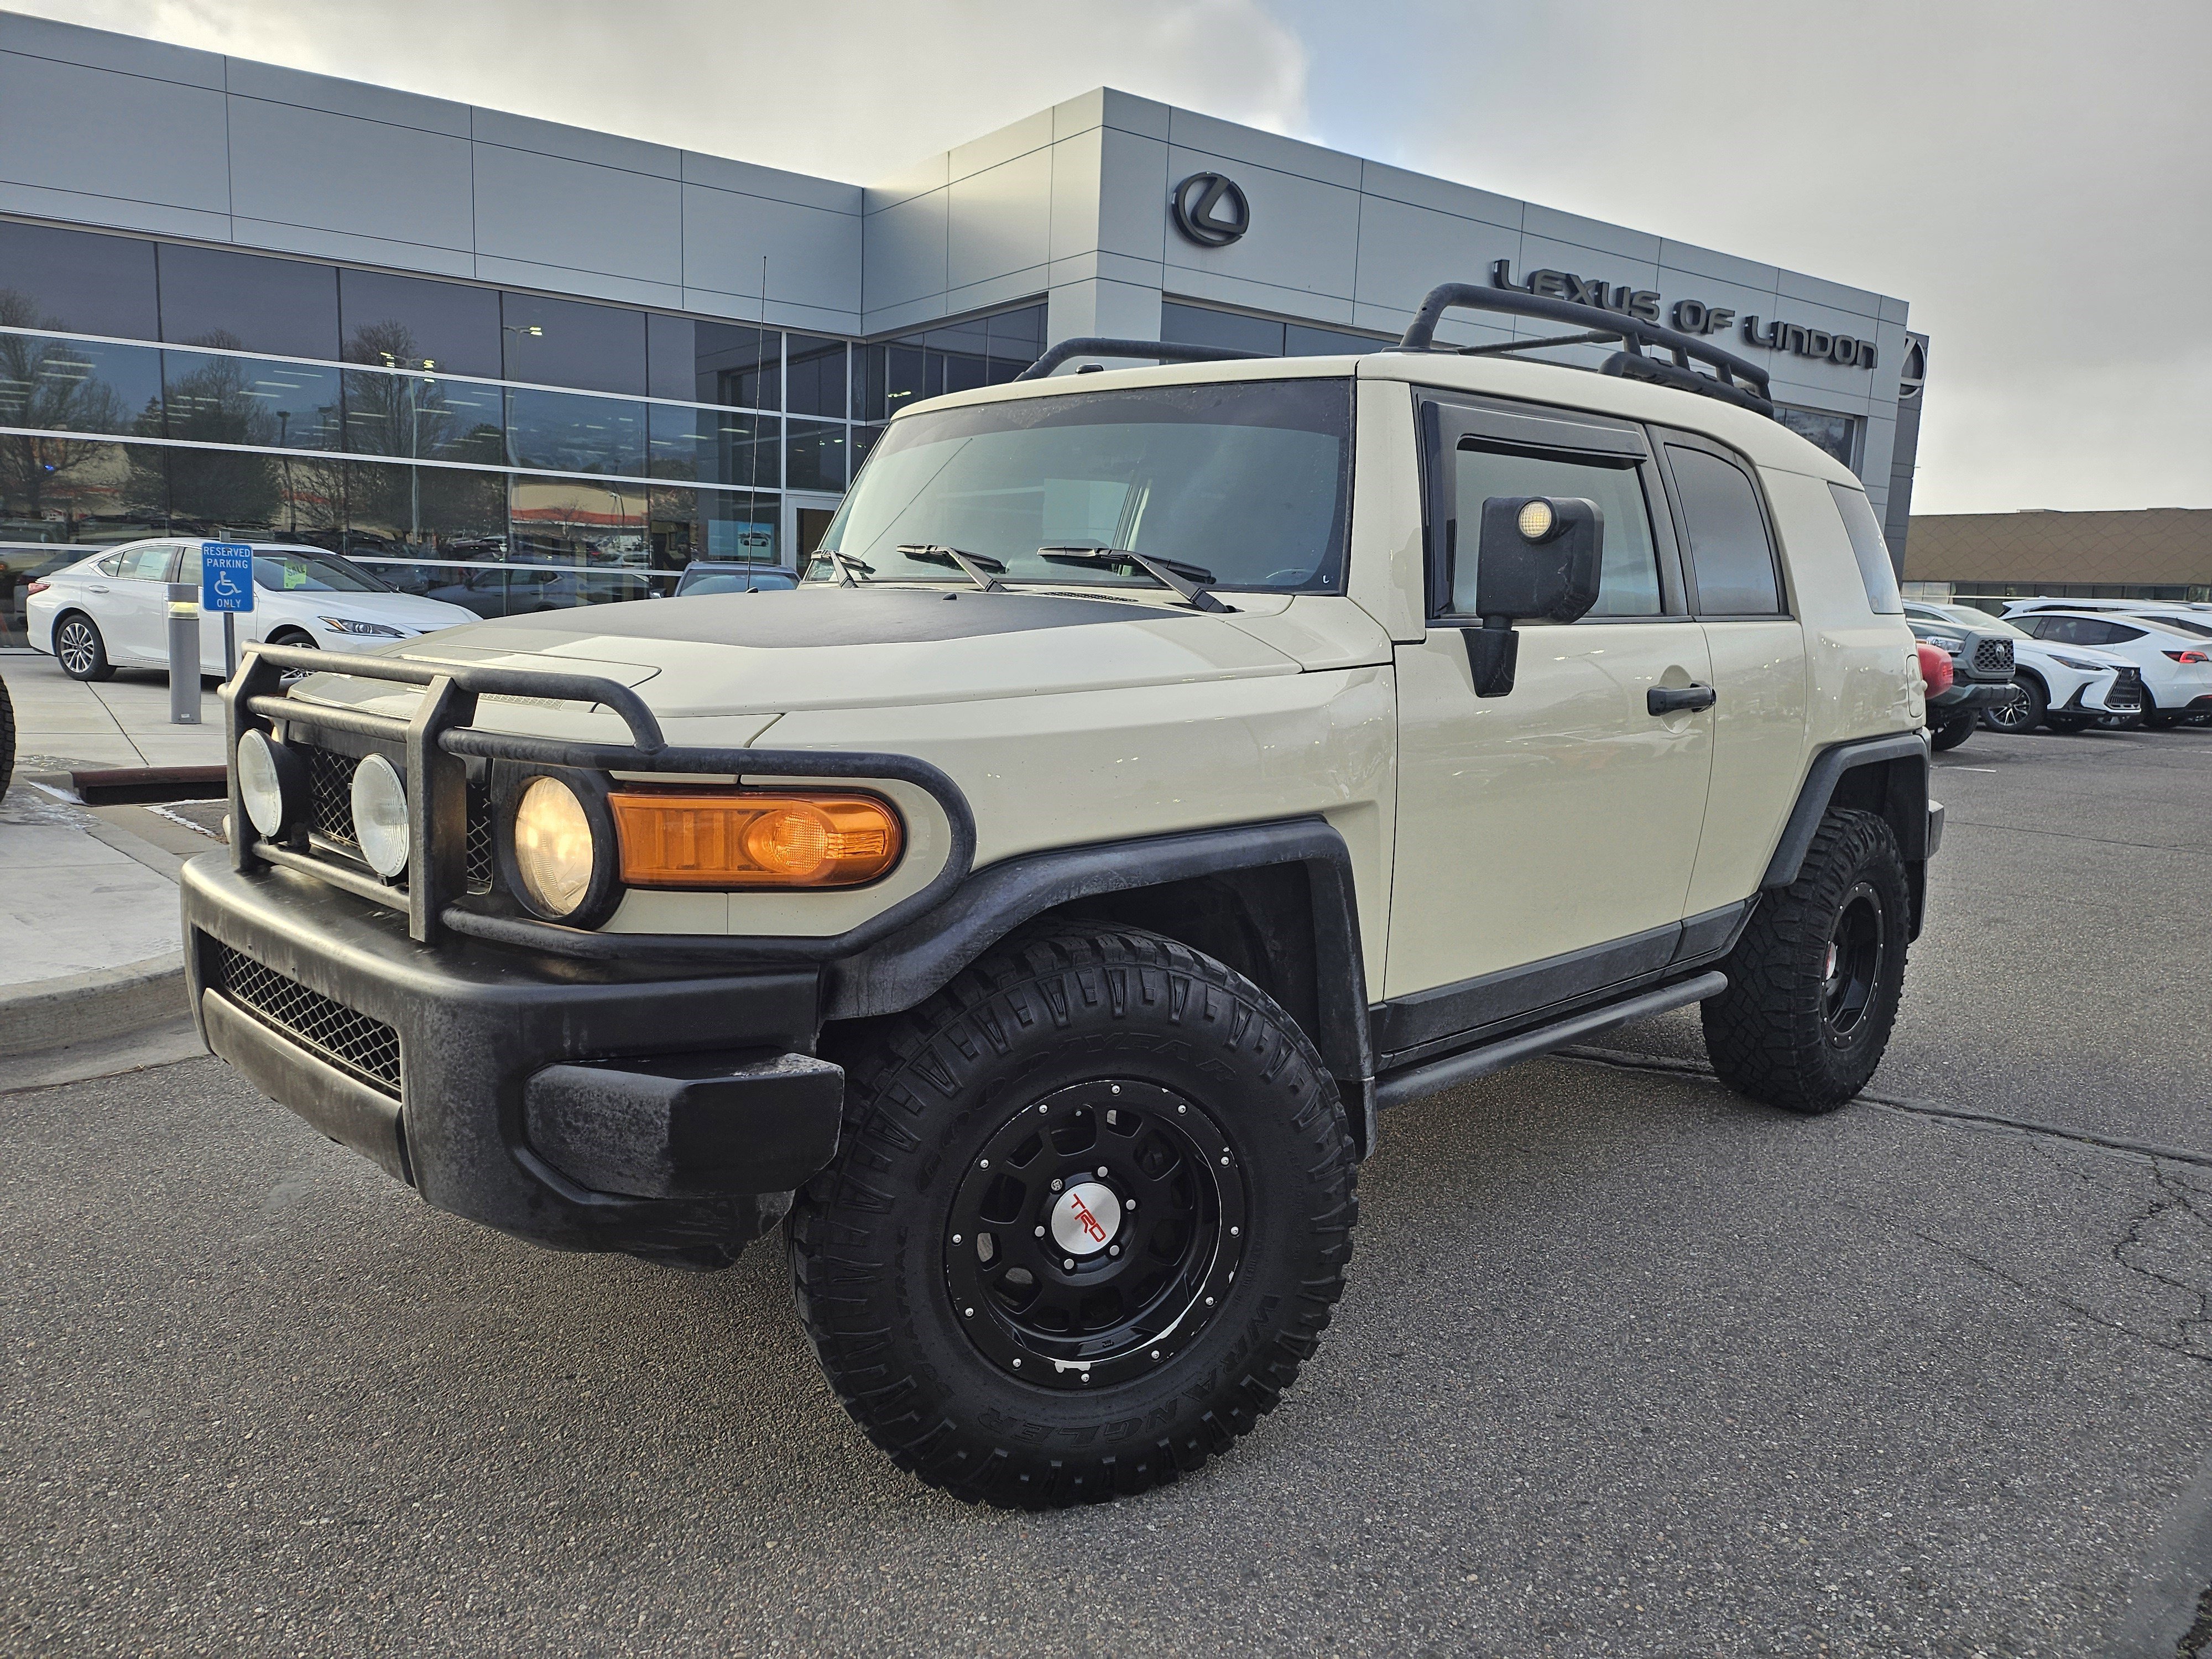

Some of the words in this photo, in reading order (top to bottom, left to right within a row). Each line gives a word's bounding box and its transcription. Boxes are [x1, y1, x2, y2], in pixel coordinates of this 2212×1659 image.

[1493, 259, 1661, 322] LEXUS
[1672, 299, 1736, 335] OF
[1745, 315, 1879, 369] LINDON
[203, 546, 251, 558] RESERVED
[207, 558, 248, 569] PARKING
[217, 598, 242, 608] ONLY
[1071, 1193, 1107, 1243] TRD
[977, 1294, 1281, 1448] WRANGLER
